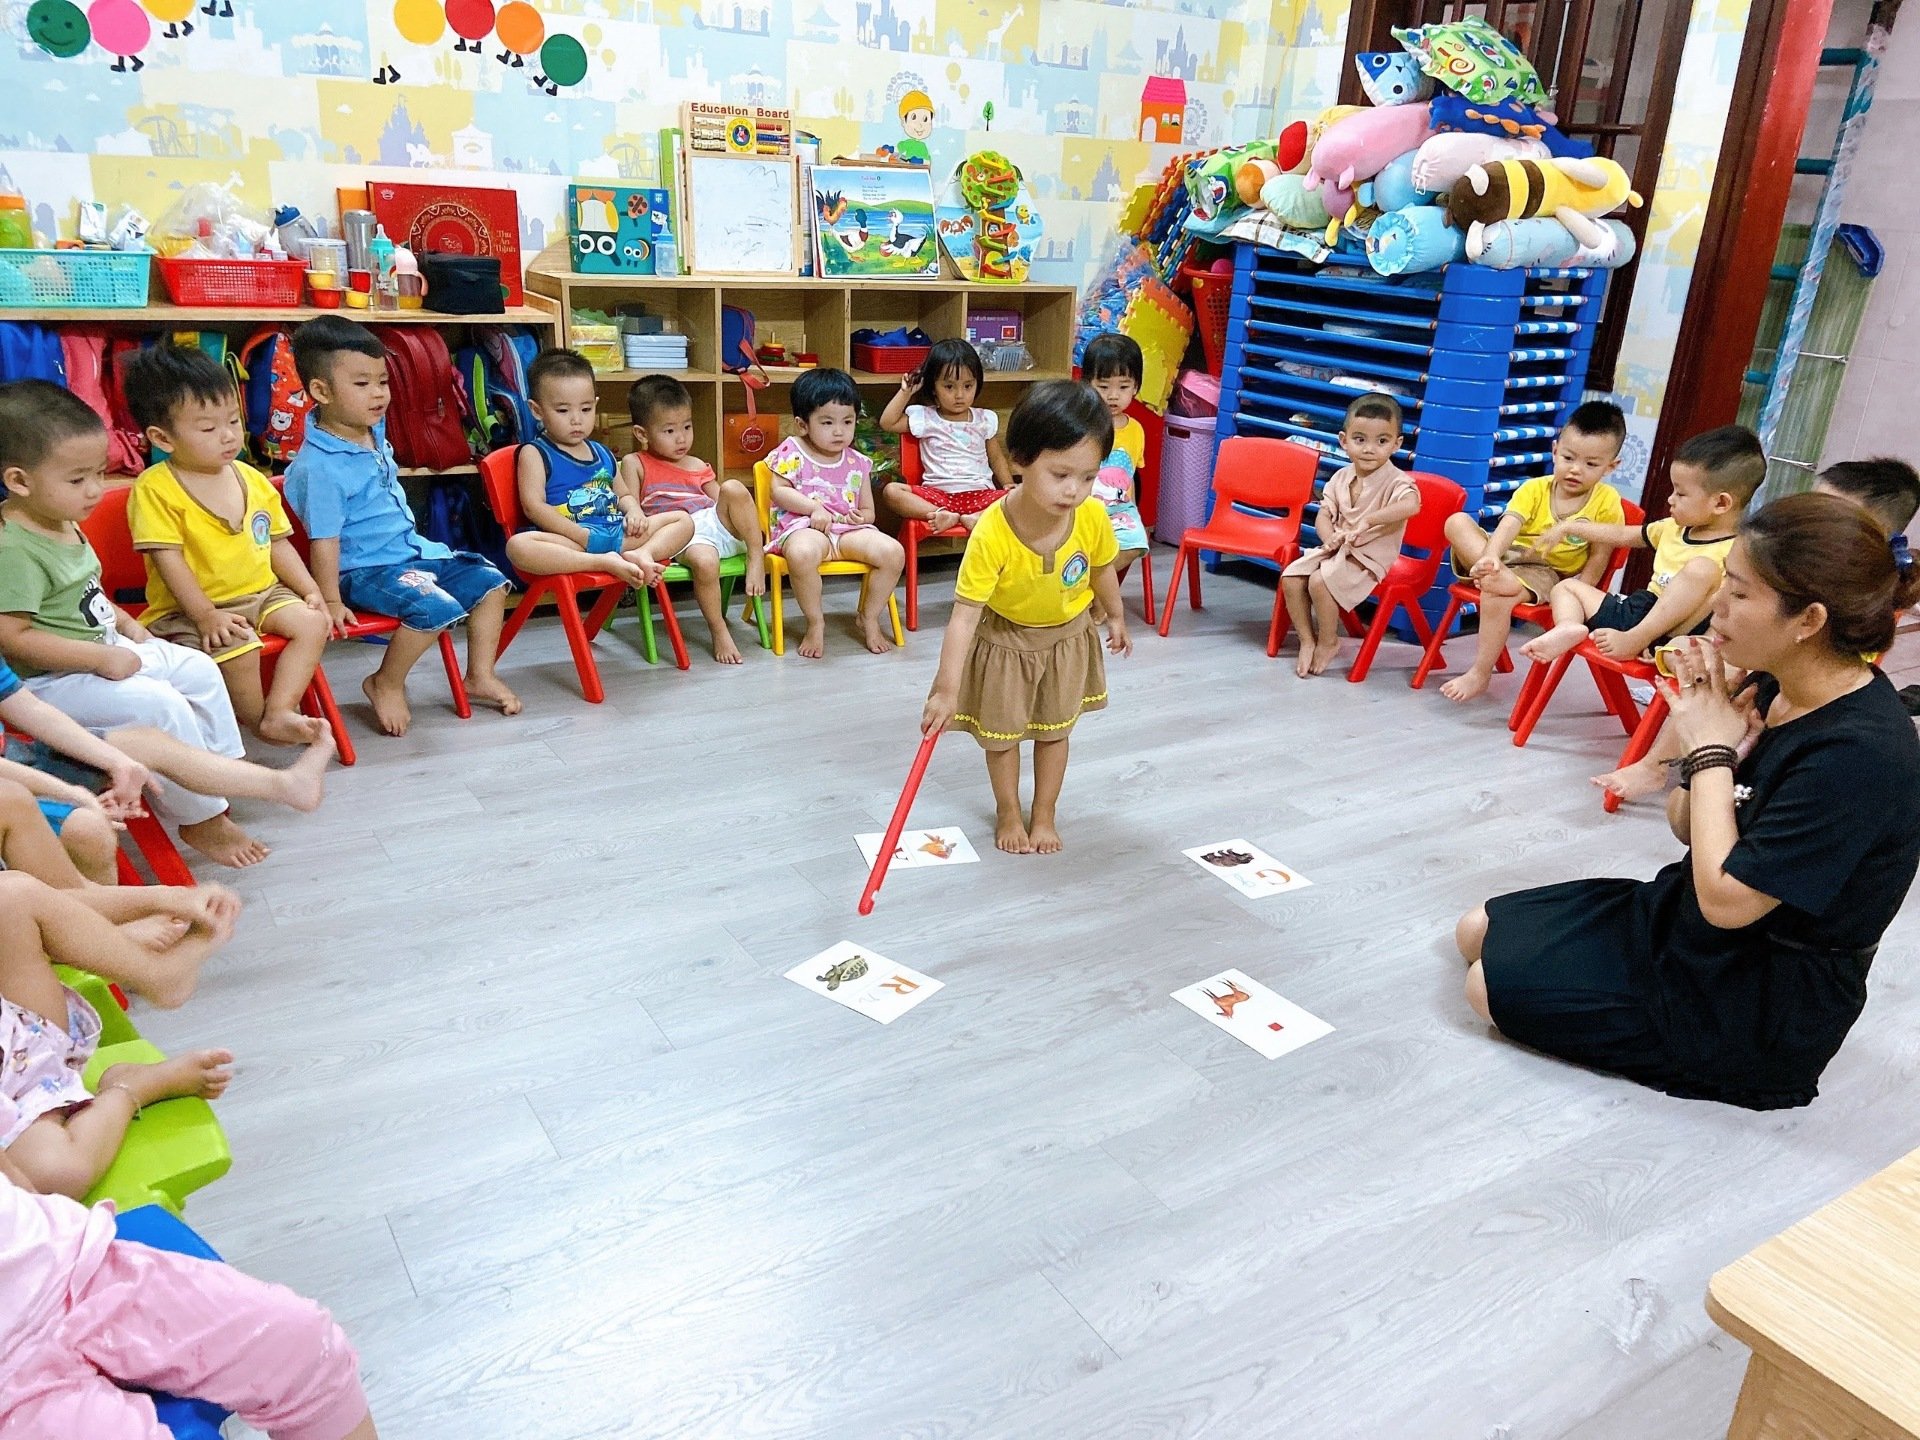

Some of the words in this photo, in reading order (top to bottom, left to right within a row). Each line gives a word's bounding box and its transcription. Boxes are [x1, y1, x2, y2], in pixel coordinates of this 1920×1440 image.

[691, 102, 749, 116] Education
[756, 107, 790, 119] Board
[879, 974, 921, 995] R
